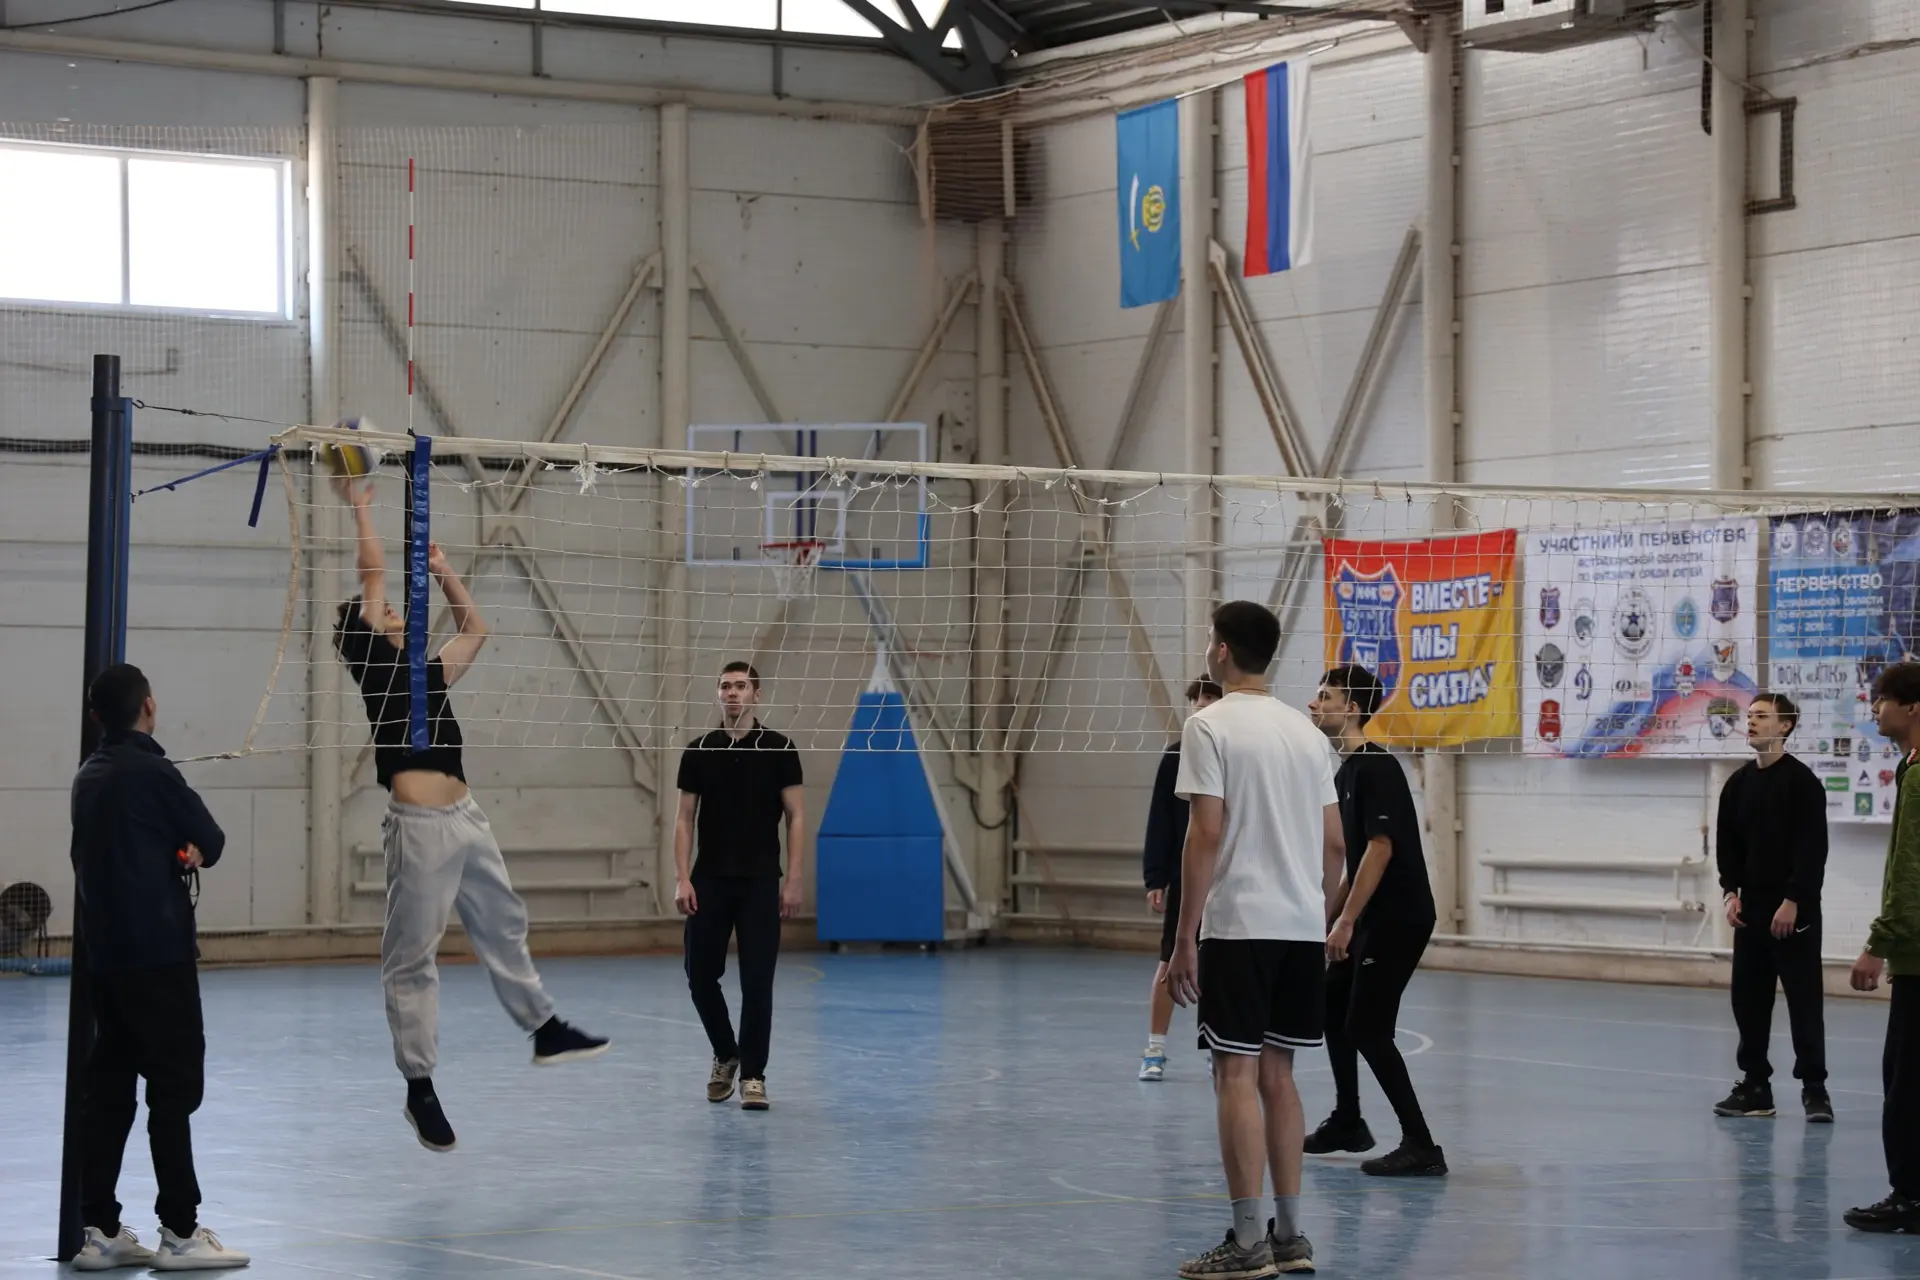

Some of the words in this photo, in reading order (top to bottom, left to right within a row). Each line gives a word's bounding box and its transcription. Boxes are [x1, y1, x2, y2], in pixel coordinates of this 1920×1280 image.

[1540, 533, 1633, 553] УЧАСТНИКИ
[1640, 528, 1746, 546] ПЕРВЕНСТВА
[1776, 572, 1883, 593] ПЕРВЕНСТВО
[1410, 622, 1460, 661] МЫ
